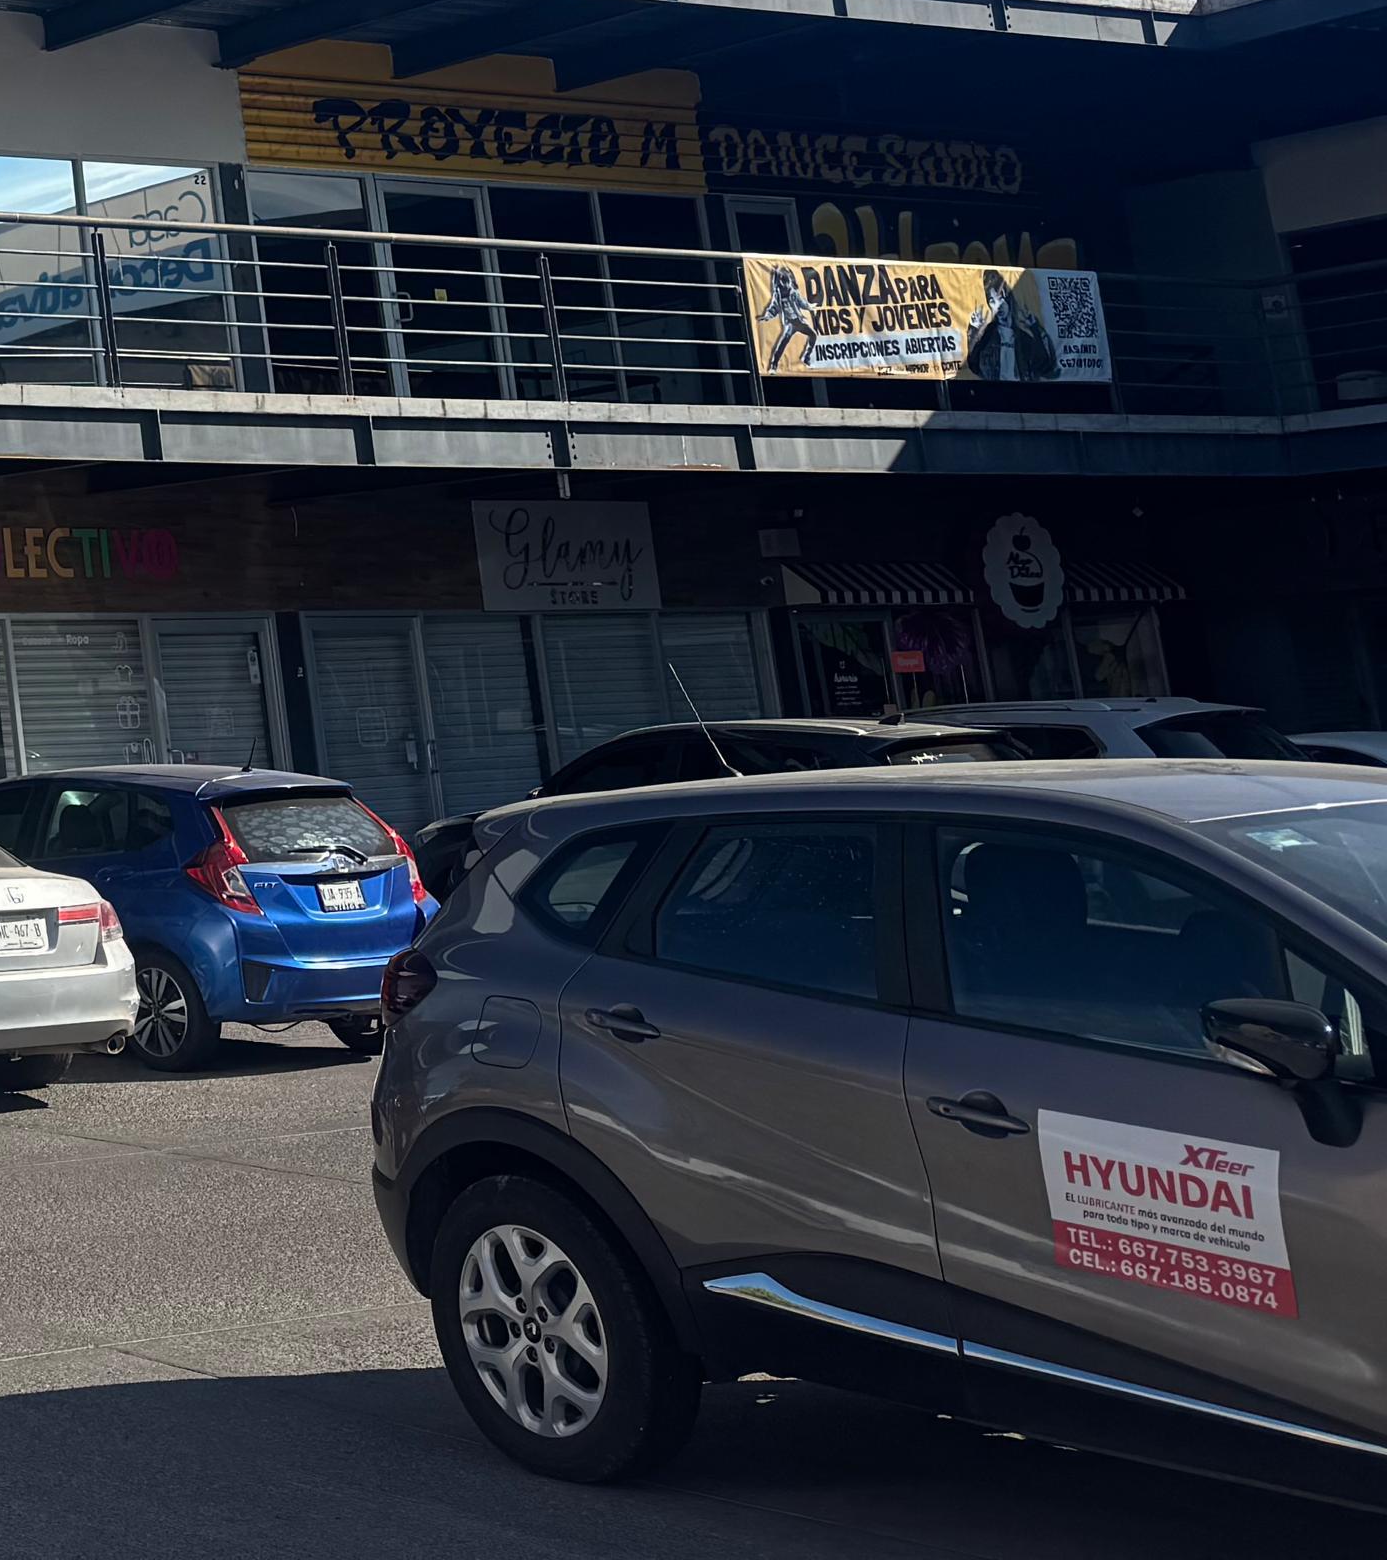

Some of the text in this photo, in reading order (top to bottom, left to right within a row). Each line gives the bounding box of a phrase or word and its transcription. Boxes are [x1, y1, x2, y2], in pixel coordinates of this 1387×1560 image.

[313, 99, 680, 170] PROYECTO M
[708, 125, 1023, 195] DANCE STUDIO
[801, 264, 944, 307] DANZA PARA
[811, 302, 953, 336] KIDS Y JOVENES
[815, 335, 957, 362] INSCRIPCIONES ABIERTAS
[489, 508, 643, 601] Glamy
[550, 590, 598, 605] STORE
[66, 634, 89, 647] Ropa
[1179, 1144, 1255, 1177] XTeer
[1063, 1150, 1255, 1220] HYUNDAI
[1065, 1192, 1265, 1243] EL LUBRICANTE más avanzado del mundo
[1083, 1209, 1104, 1222] para
[1131, 1217, 1150, 1233] tipo
[1151, 1222, 1158, 1234] y
[1160, 1226, 1191, 1240] marca
[1193, 1229, 1206, 1242] de
[1067, 1226, 1276, 1288] TEL.: 667.753.3967
[1069, 1248, 1278, 1309] CEL.: 667.185.0874
